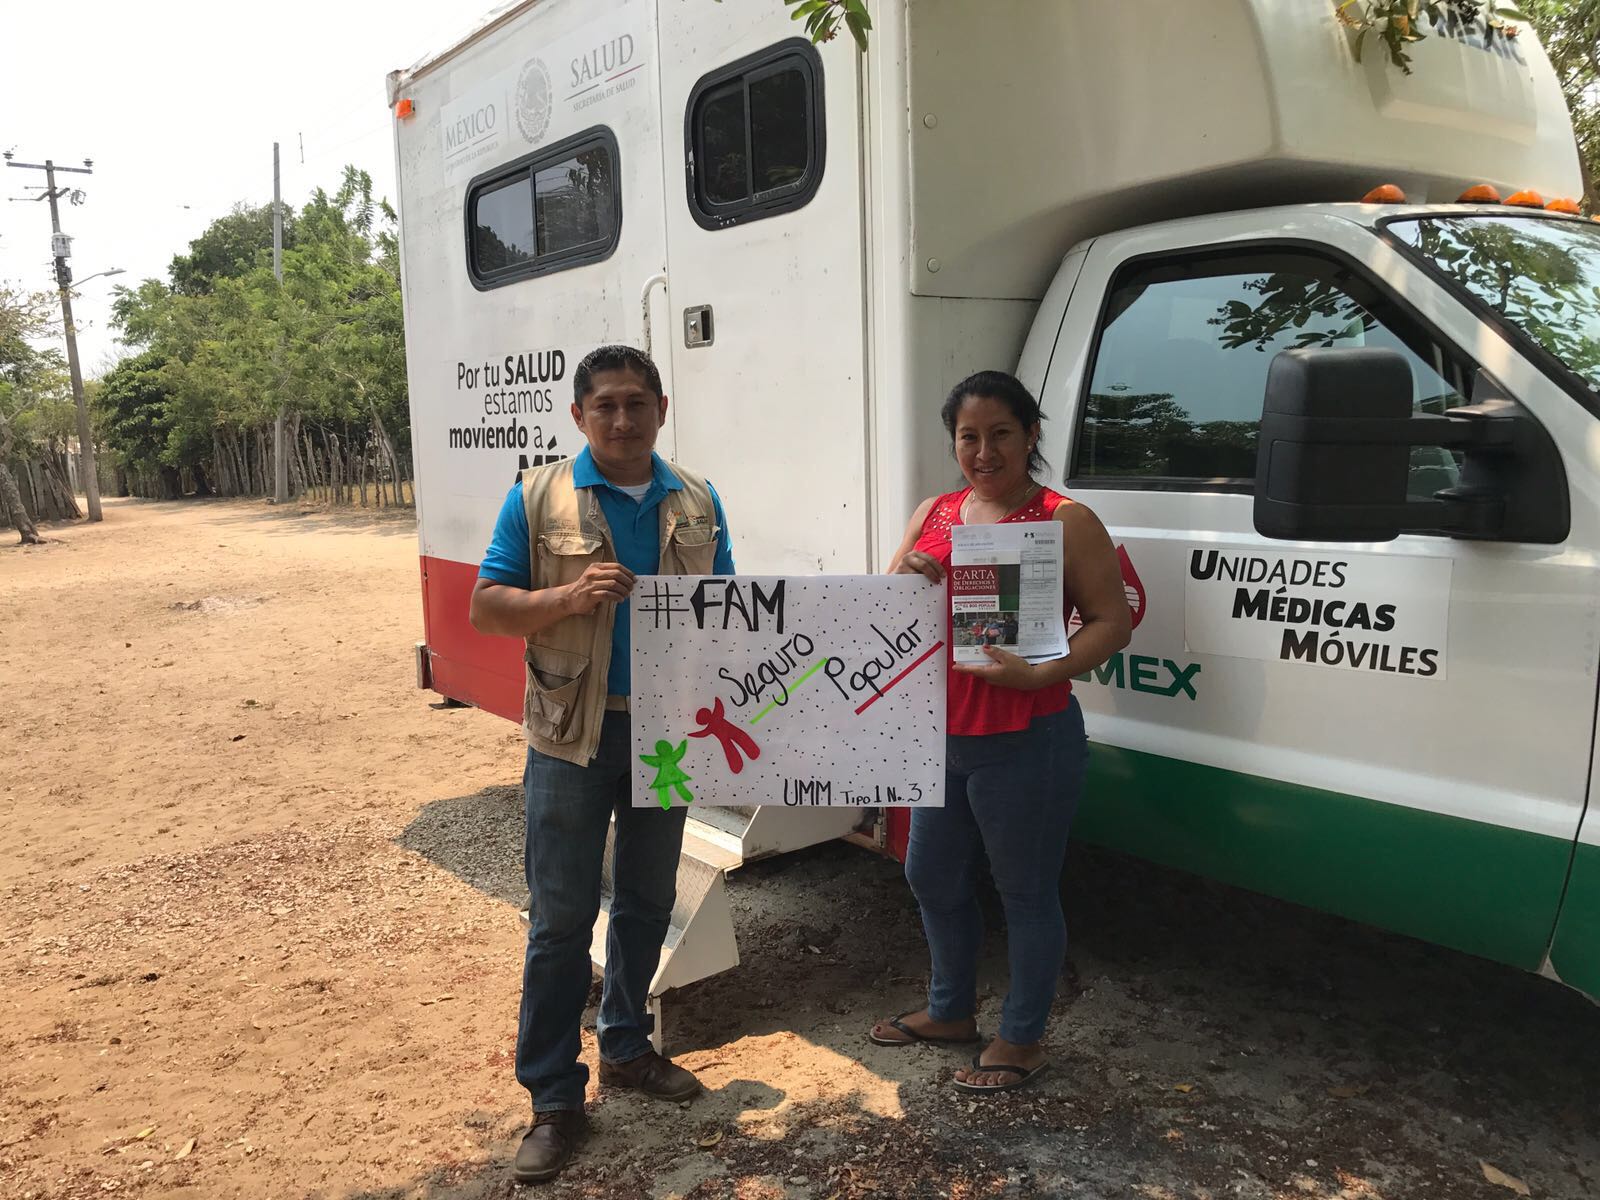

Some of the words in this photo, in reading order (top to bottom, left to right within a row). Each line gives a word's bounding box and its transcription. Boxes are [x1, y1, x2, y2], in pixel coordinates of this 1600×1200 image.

[571, 33, 634, 88] SALUD
[616, 78, 636, 93] SALUD
[446, 103, 496, 152] MÉXICO
[458, 362, 480, 390] Por
[484, 362, 500, 388] tu
[504, 350, 566, 386] SALUD
[484, 388, 553, 416] estamos
[449, 417, 528, 449] moviendo
[534, 425, 544, 449] a
[953, 569, 995, 580] CARTA
[1190, 549, 1348, 588] UNIDADES
[638, 579, 786, 634] #FAM
[1232, 586, 1397, 632] MÉDICAS
[718, 633, 815, 707] Seguro
[823, 618, 923, 701] Popular
[1279, 628, 1440, 677] MÓVILES
[783, 778, 832, 806] UMM
[840, 790, 871, 806] Tipo
[873, 785, 882, 803] 1
[907, 783, 923, 802] 3
